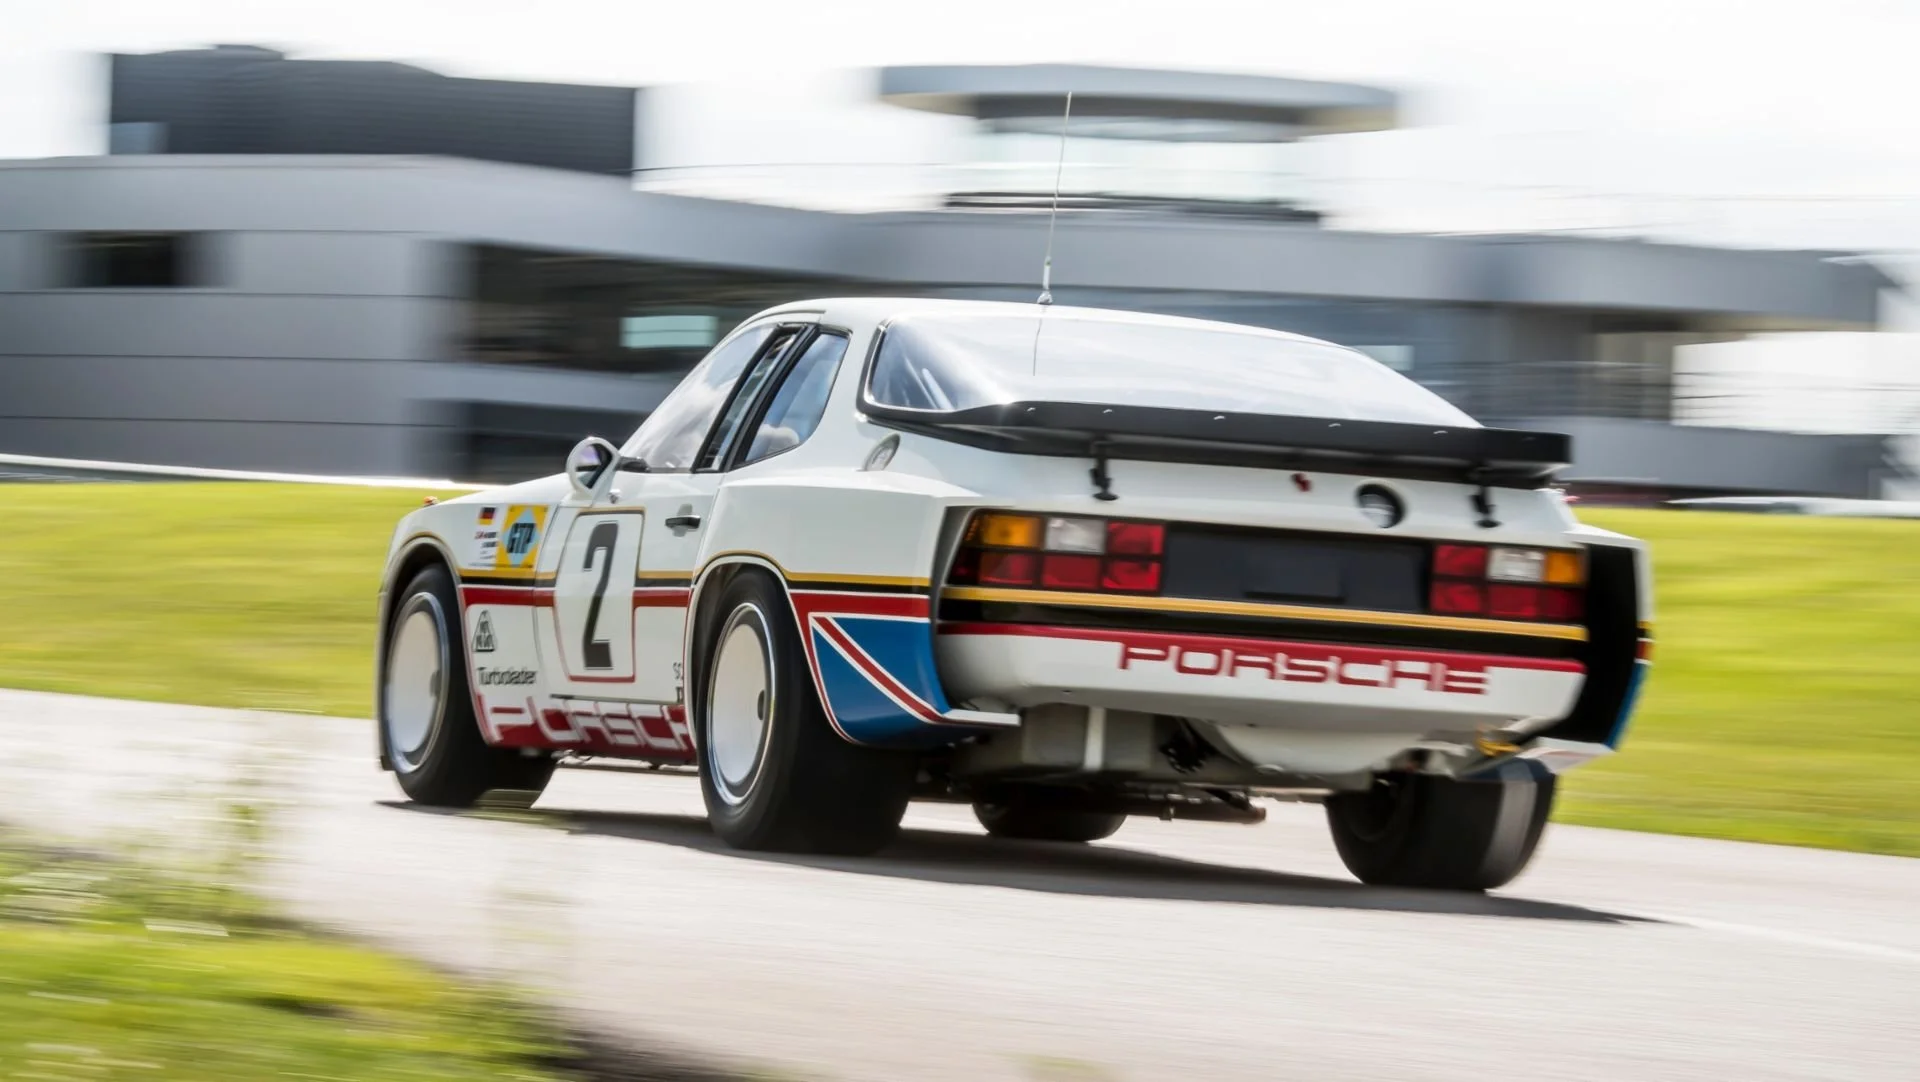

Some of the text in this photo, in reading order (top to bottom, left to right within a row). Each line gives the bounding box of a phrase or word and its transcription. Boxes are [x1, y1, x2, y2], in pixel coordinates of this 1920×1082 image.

[506, 522, 537, 554] GTP
[582, 520, 620, 671] 2
[477, 667, 537, 685] Turbolader
[1118, 642, 1490, 695] PORSCHE
